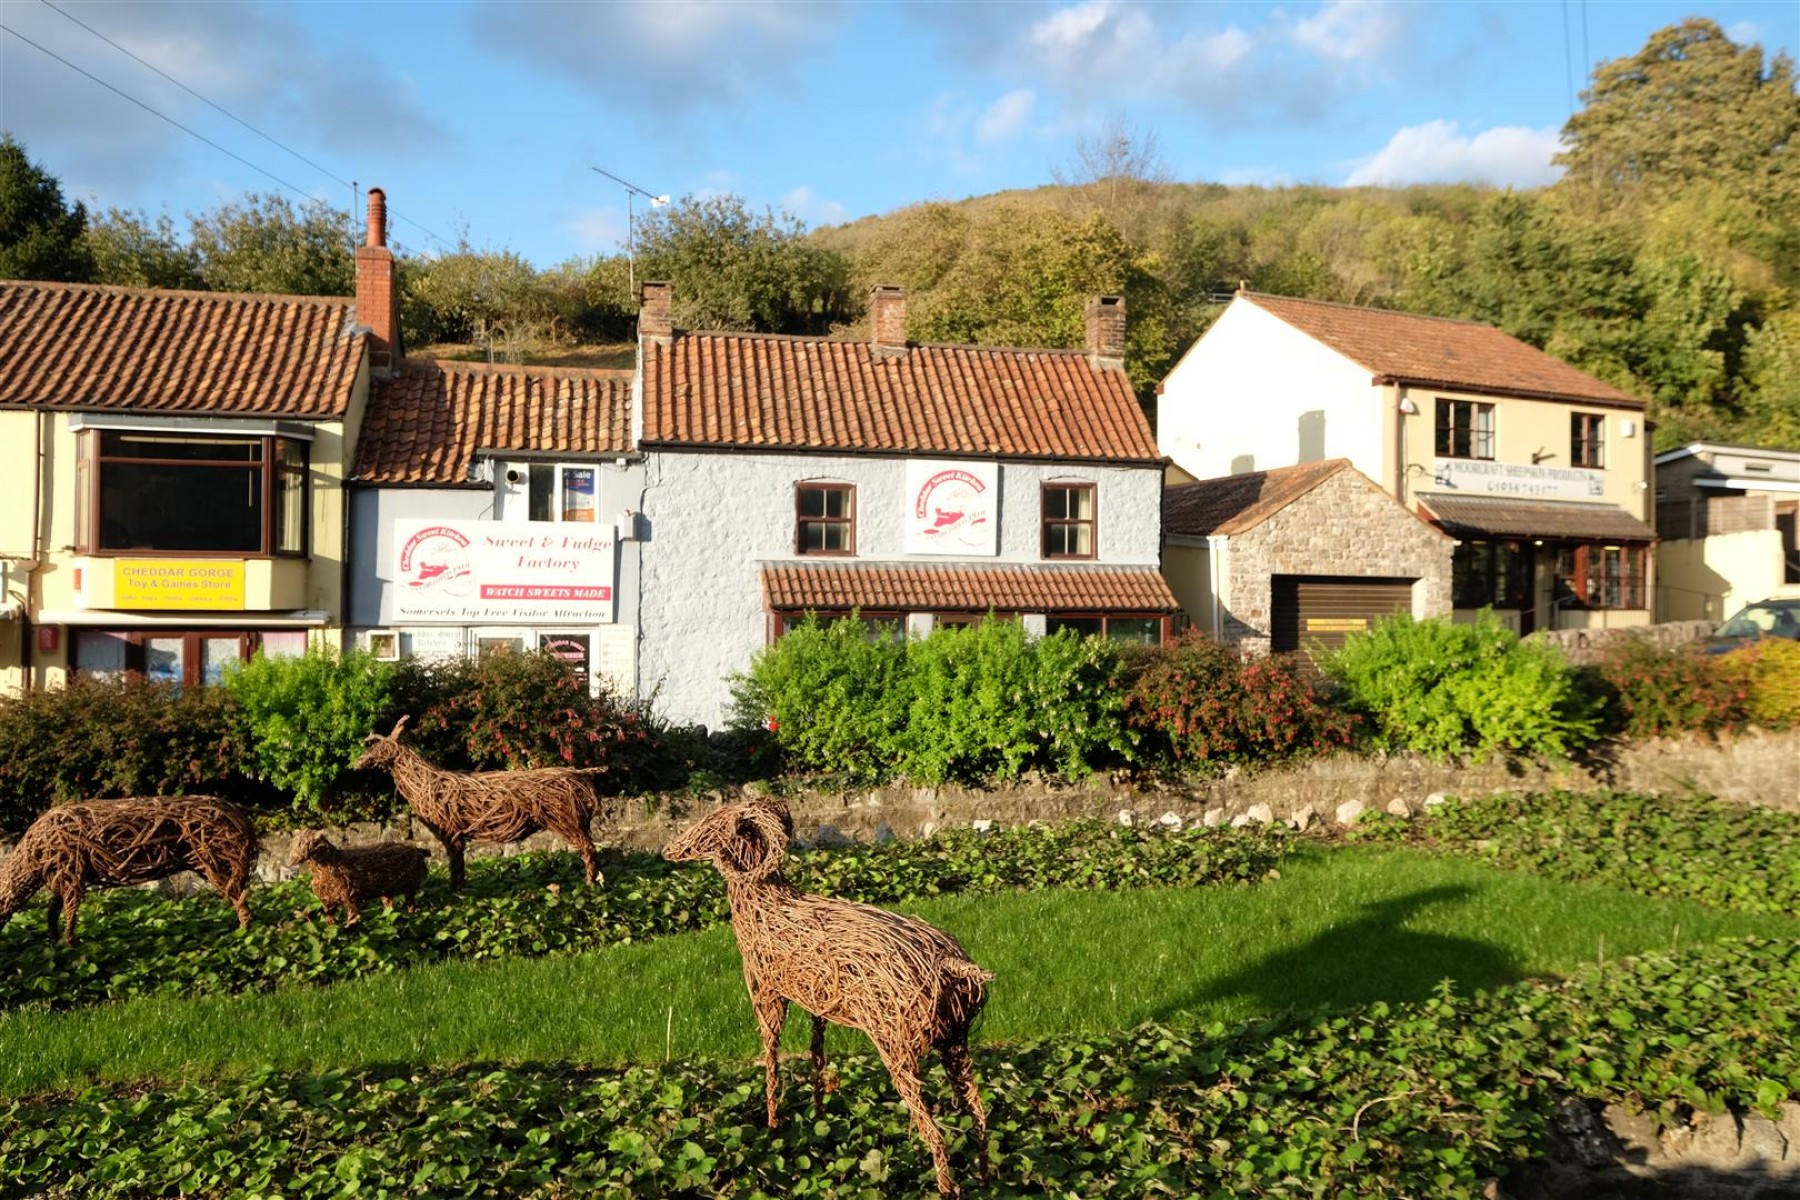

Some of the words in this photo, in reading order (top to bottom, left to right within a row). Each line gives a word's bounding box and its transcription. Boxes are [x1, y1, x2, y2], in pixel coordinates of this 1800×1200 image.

[484, 536, 534, 548] Sweet
[541, 536, 554, 548] &
[562, 536, 612, 552] Fudge
[518, 555, 580, 573] Factory
[122, 567, 185, 577] CHEDDAR
[189, 568, 233, 578] GORGE
[129, 579, 148, 589] Toy
[151, 579, 158, 588] &
[161, 580, 198, 589] Games
[201, 580, 231, 589] Store
[485, 587, 525, 597] WATCH
[527, 587, 571, 598] SWEETS
[573, 588, 606, 599] MADE
[400, 607, 456, 616] Somersets
[461, 607, 480, 618] Top
[484, 608, 508, 616] Free
[513, 608, 549, 617] Visitor
[554, 609, 606, 618] Attraction
